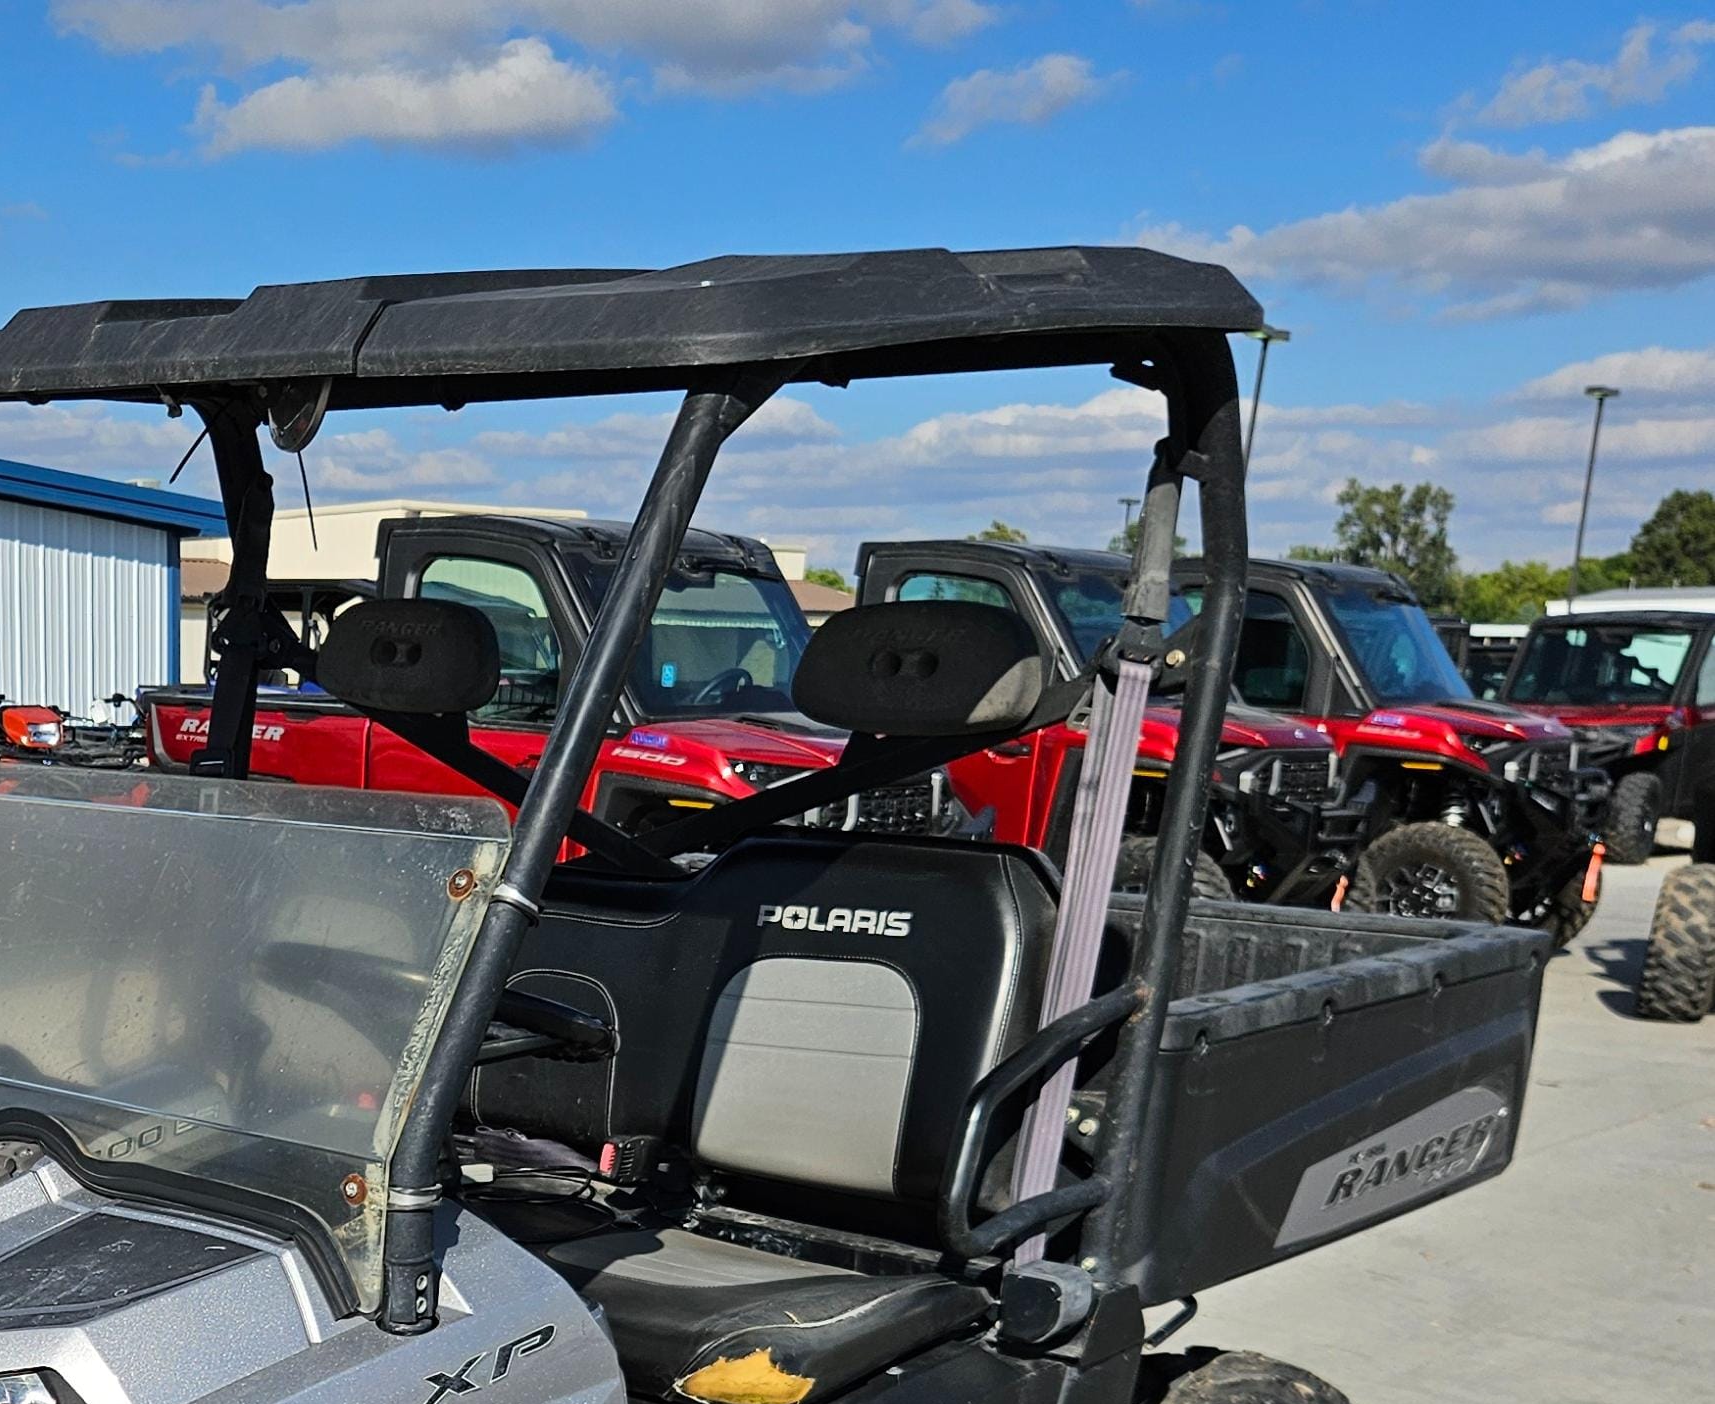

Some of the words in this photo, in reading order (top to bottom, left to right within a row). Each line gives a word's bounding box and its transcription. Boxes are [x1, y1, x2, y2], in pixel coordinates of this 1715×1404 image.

[180, 718, 285, 741] RAER
[757, 904, 914, 937] POLARIS
[91, 1124, 163, 1158] 00
[1320, 1115, 1497, 1210] RANGER
